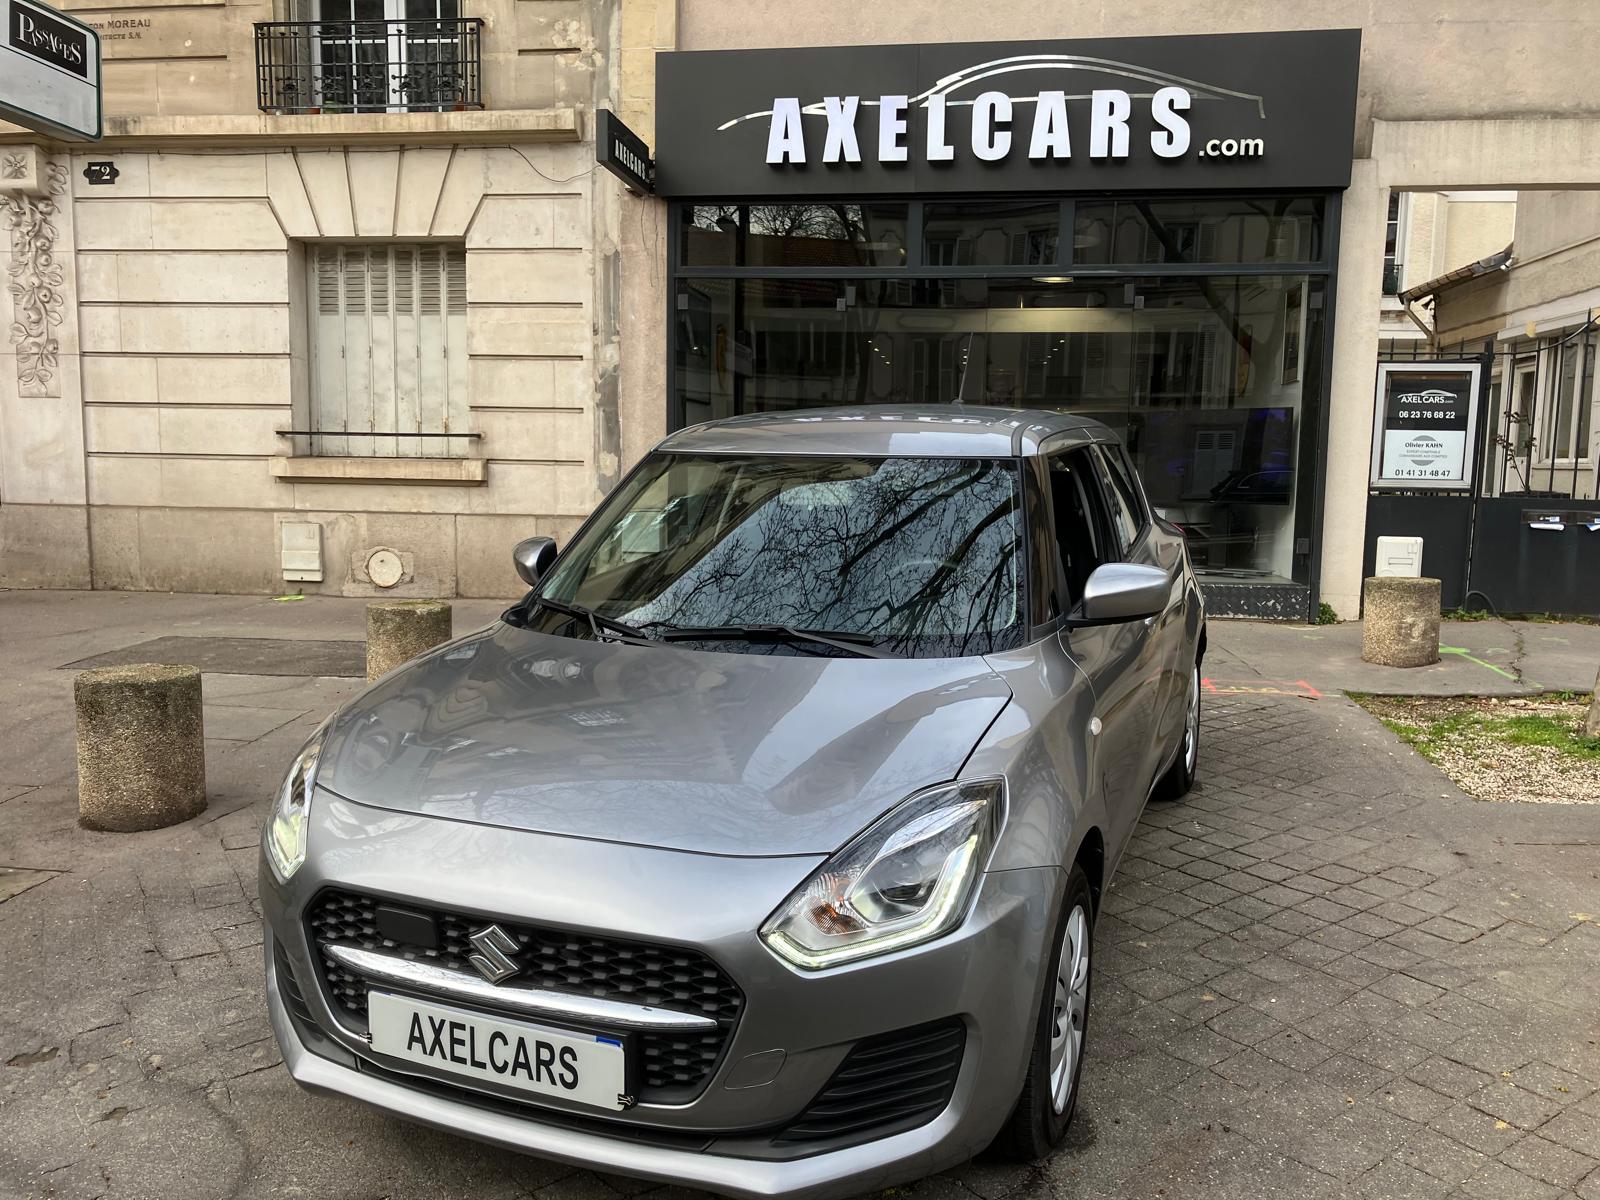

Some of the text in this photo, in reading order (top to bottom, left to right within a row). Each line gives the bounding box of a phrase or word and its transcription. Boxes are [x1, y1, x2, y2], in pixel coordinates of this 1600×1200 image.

[107, 19, 151, 29] MOREAU
[614, 138, 646, 180] AXELCARS
[90, 165, 111, 180] 72
[1417, 469, 1427, 477] 31
[1429, 469, 1439, 477] 48
[406, 1012, 579, 1090] AXELCARS
